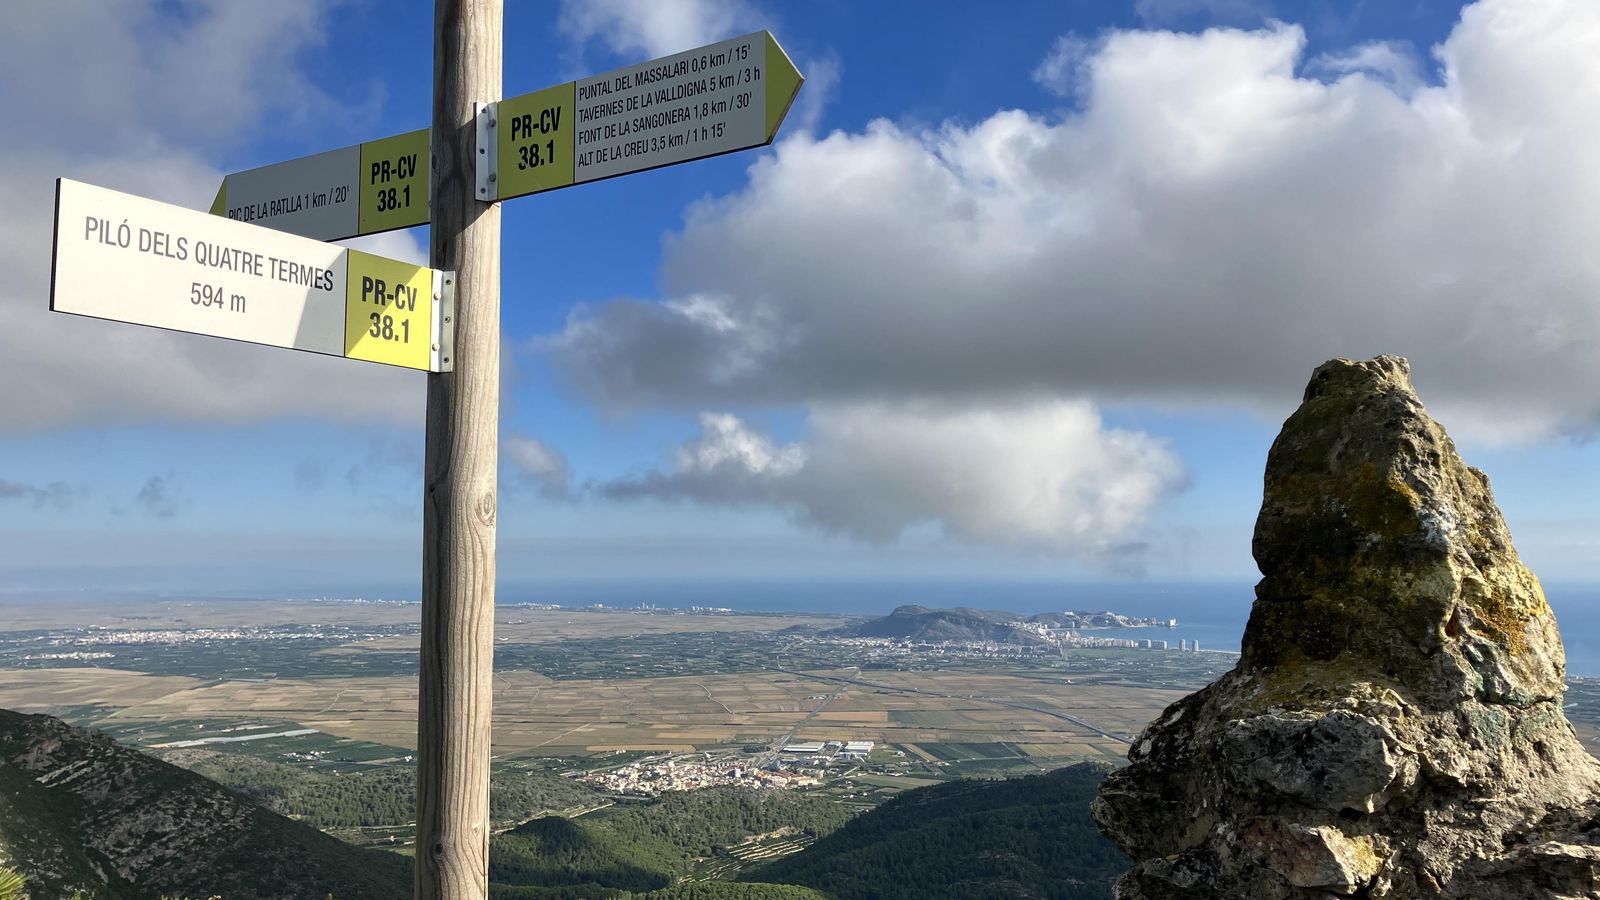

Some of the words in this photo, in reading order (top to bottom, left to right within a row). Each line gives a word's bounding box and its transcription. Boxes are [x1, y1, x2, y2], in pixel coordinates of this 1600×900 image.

[580, 82, 611, 101] PUNTAL
[615, 77, 632, 91] DEL
[635, 60, 689, 88] MASSALARI
[692, 57, 707, 74] 0,6
[710, 52, 725, 67] km
[728, 49, 732, 62] /
[736, 45, 751, 59] 15'
[579, 101, 623, 123] TAVERNES
[626, 96, 638, 111] DE
[641, 92, 653, 107] LA
[655, 80, 707, 105] VALLDIGNA
[710, 78, 716, 91] 5
[718, 72, 735, 88] km
[737, 70, 742, 83] /
[744, 69, 751, 82] 3
[754, 66, 760, 80] h
[511, 107, 561, 142] PR-CV
[579, 127, 601, 145] FONT
[604, 123, 616, 138] DE
[619, 120, 631, 135] LA
[633, 108, 691, 133] SANGONERA
[694, 104, 708, 122] 1,8
[711, 99, 727, 114] km
[729, 96, 734, 110] /
[736, 93, 752, 108] 30'
[518, 139, 554, 170] 38.1
[578, 150, 593, 168] ALT
[596, 147, 608, 162] DE
[611, 144, 622, 160] LA
[624, 140, 648, 158] CREU
[651, 137, 666, 152] 3,5
[668, 131, 684, 146] km
[686, 130, 691, 143] /
[694, 129, 698, 141] 1
[702, 127, 708, 139] h
[711, 122, 726, 138] 15'
[371, 154, 417, 184] PR-CV
[244, 205, 255, 221] DE
[257, 202, 268, 219] LA
[270, 195, 302, 216] RATLLA
[305, 194, 309, 209] 1
[312, 191, 326, 208] km
[328, 188, 332, 205] /
[335, 185, 349, 204] 20'
[377, 185, 410, 212] 38.1
[85, 216, 131, 248] PILÓ
[139, 228, 188, 261] DELS
[195, 241, 263, 277] QUATRE
[269, 257, 334, 292] TERMES
[190, 282, 223, 309] 594
[230, 295, 246, 313] m
[362, 276, 418, 312] PR-CV
[369, 312, 410, 344] 38.1
